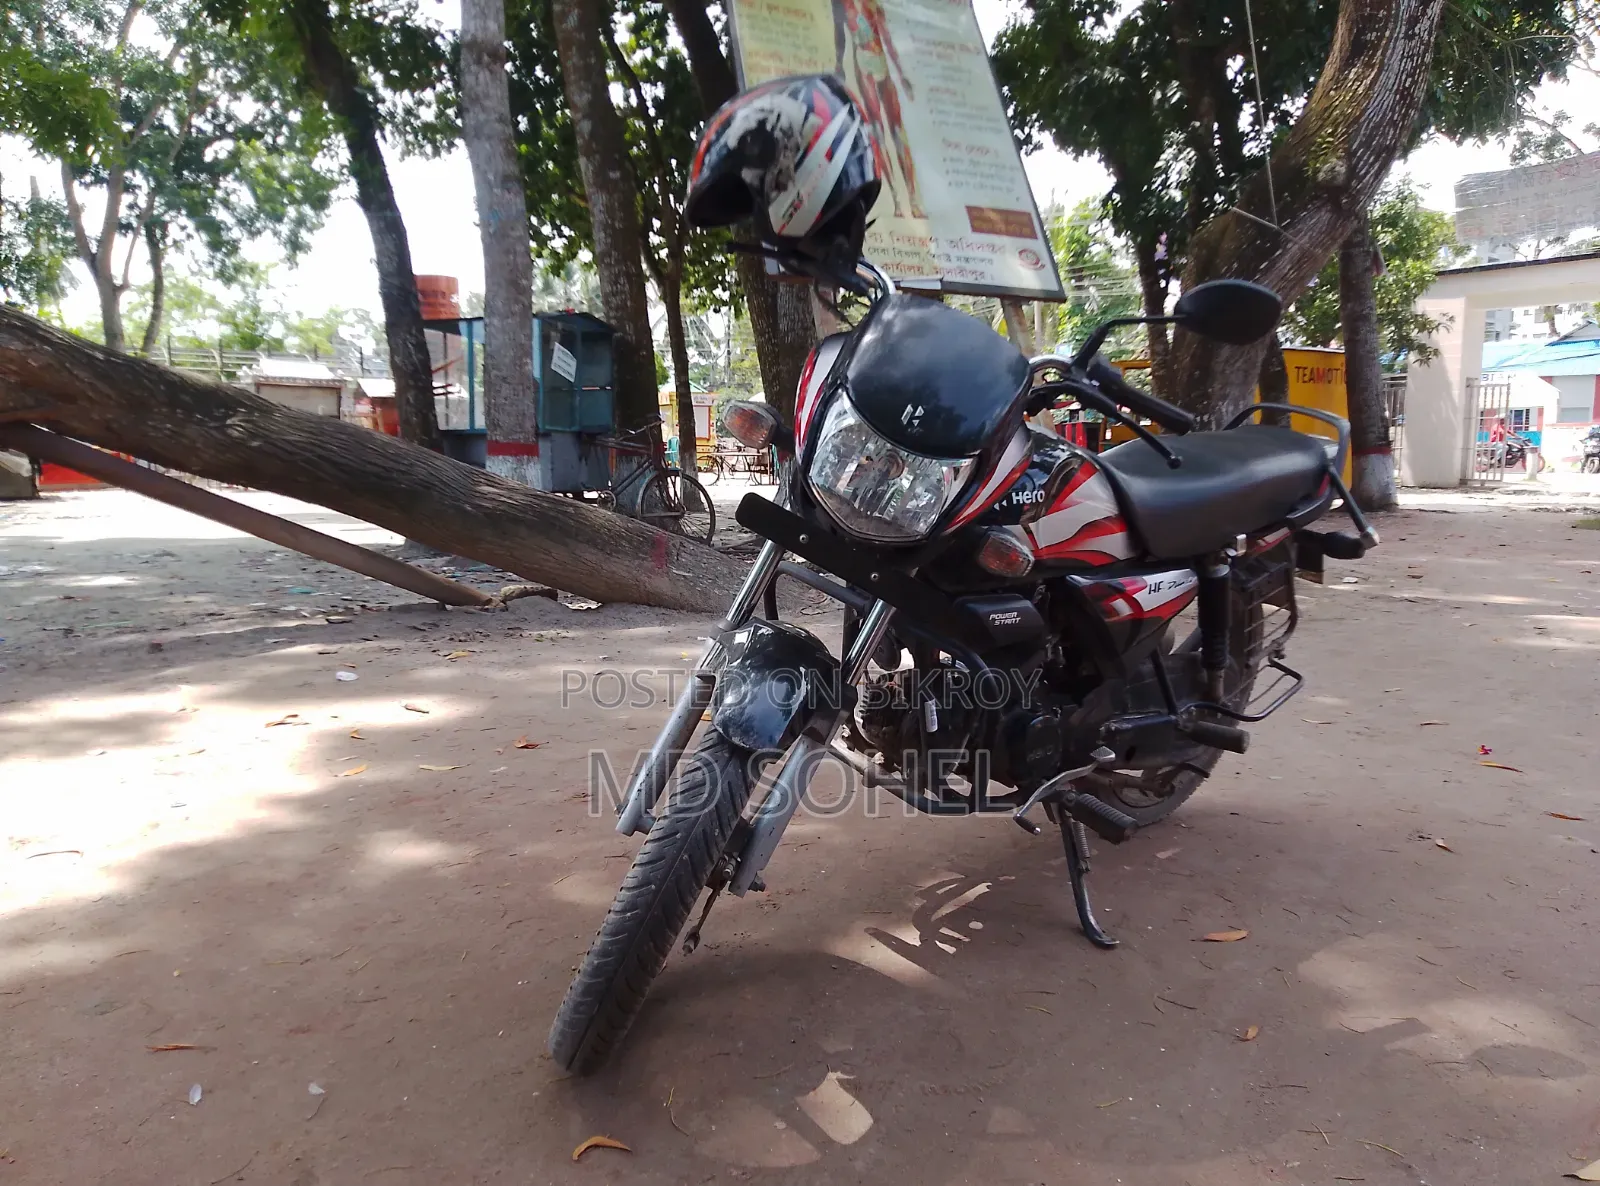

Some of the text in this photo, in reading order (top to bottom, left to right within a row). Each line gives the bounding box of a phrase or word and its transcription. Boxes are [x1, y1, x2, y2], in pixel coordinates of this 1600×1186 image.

[1012, 490, 1045, 504] Hero
[1148, 581, 1164, 594] HF
[989, 611, 1018, 621] POWER
[994, 617, 1021, 626] START
